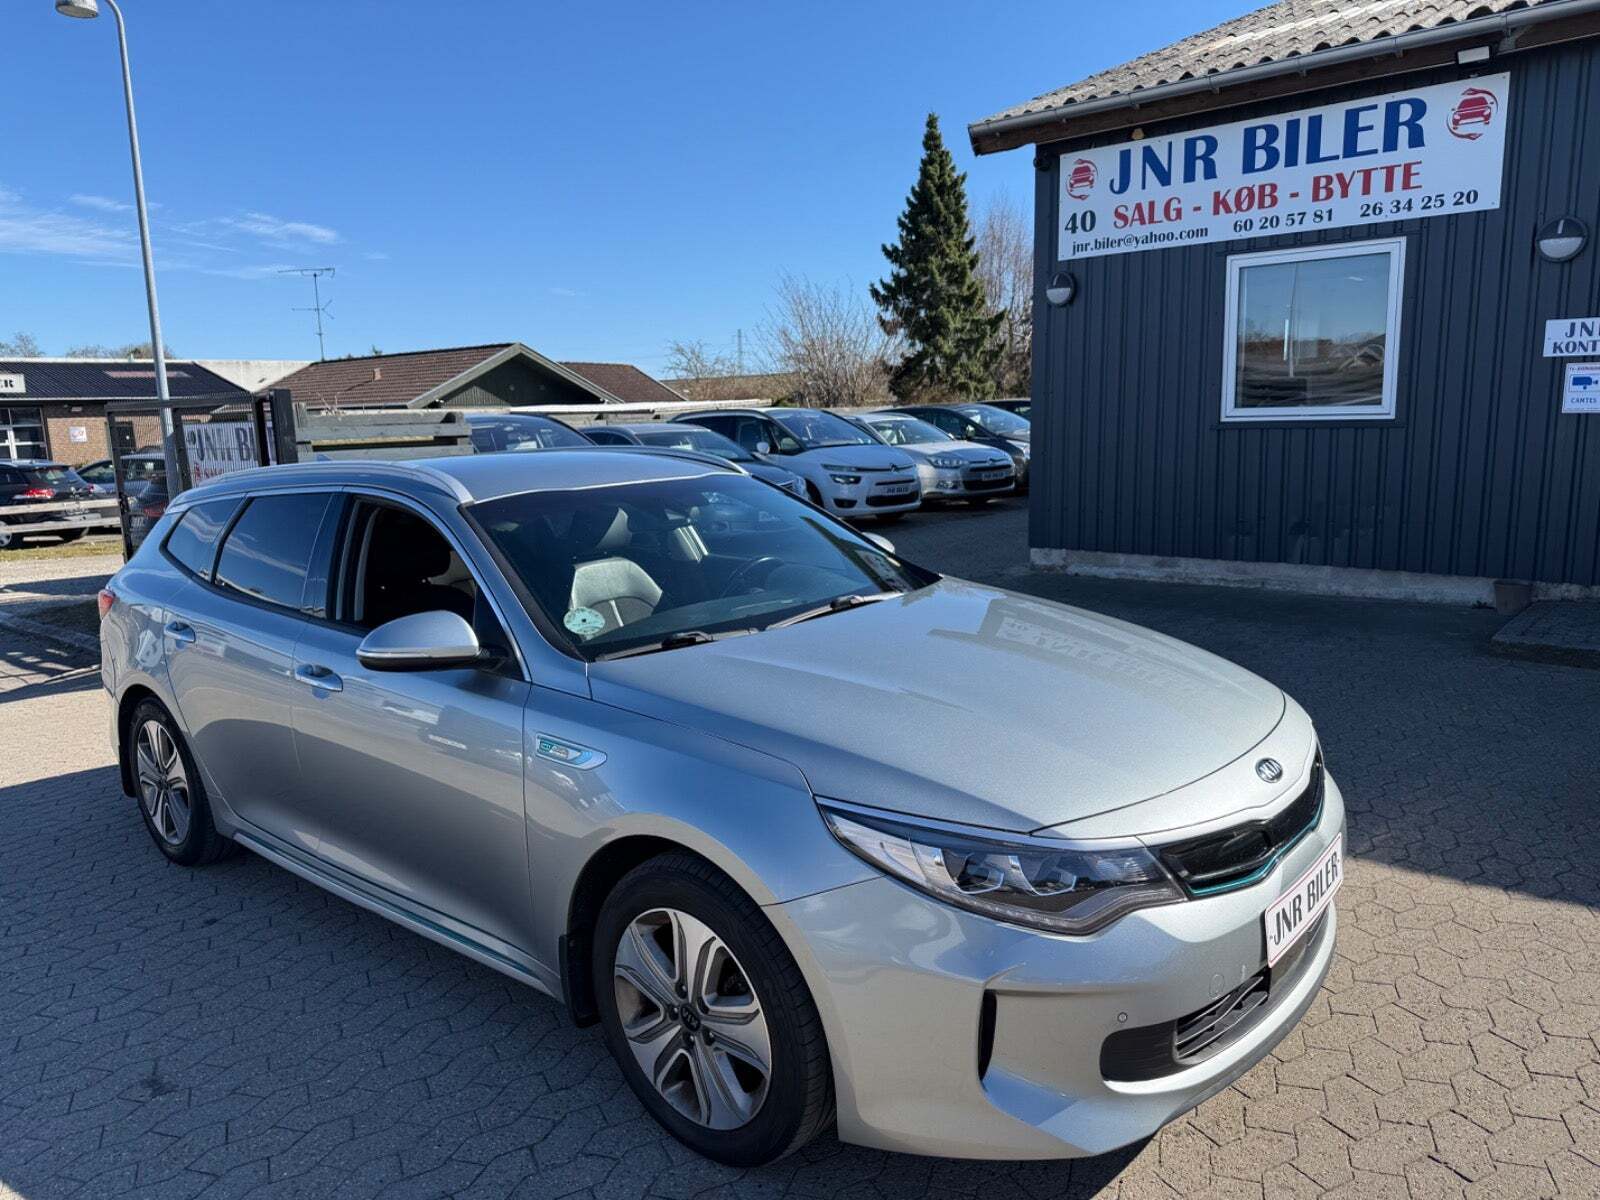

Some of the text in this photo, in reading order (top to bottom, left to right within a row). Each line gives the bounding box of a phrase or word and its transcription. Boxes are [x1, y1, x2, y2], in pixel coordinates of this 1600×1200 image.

[1109, 97, 1428, 195] JNR BILER
[1113, 196, 1183, 229] SALG
[1212, 182, 1279, 216] KØB
[1311, 160, 1423, 203] BYTTE
[1233, 188, 1479, 233] 60 20 57 81 26 34 25 20
[1064, 209, 1097, 235] 40
[1071, 226, 1209, 256] jnr.biler@yahoo.com
[1564, 321, 1600, 338] JN
[1274, 851, 1338, 946] JNR BILER
